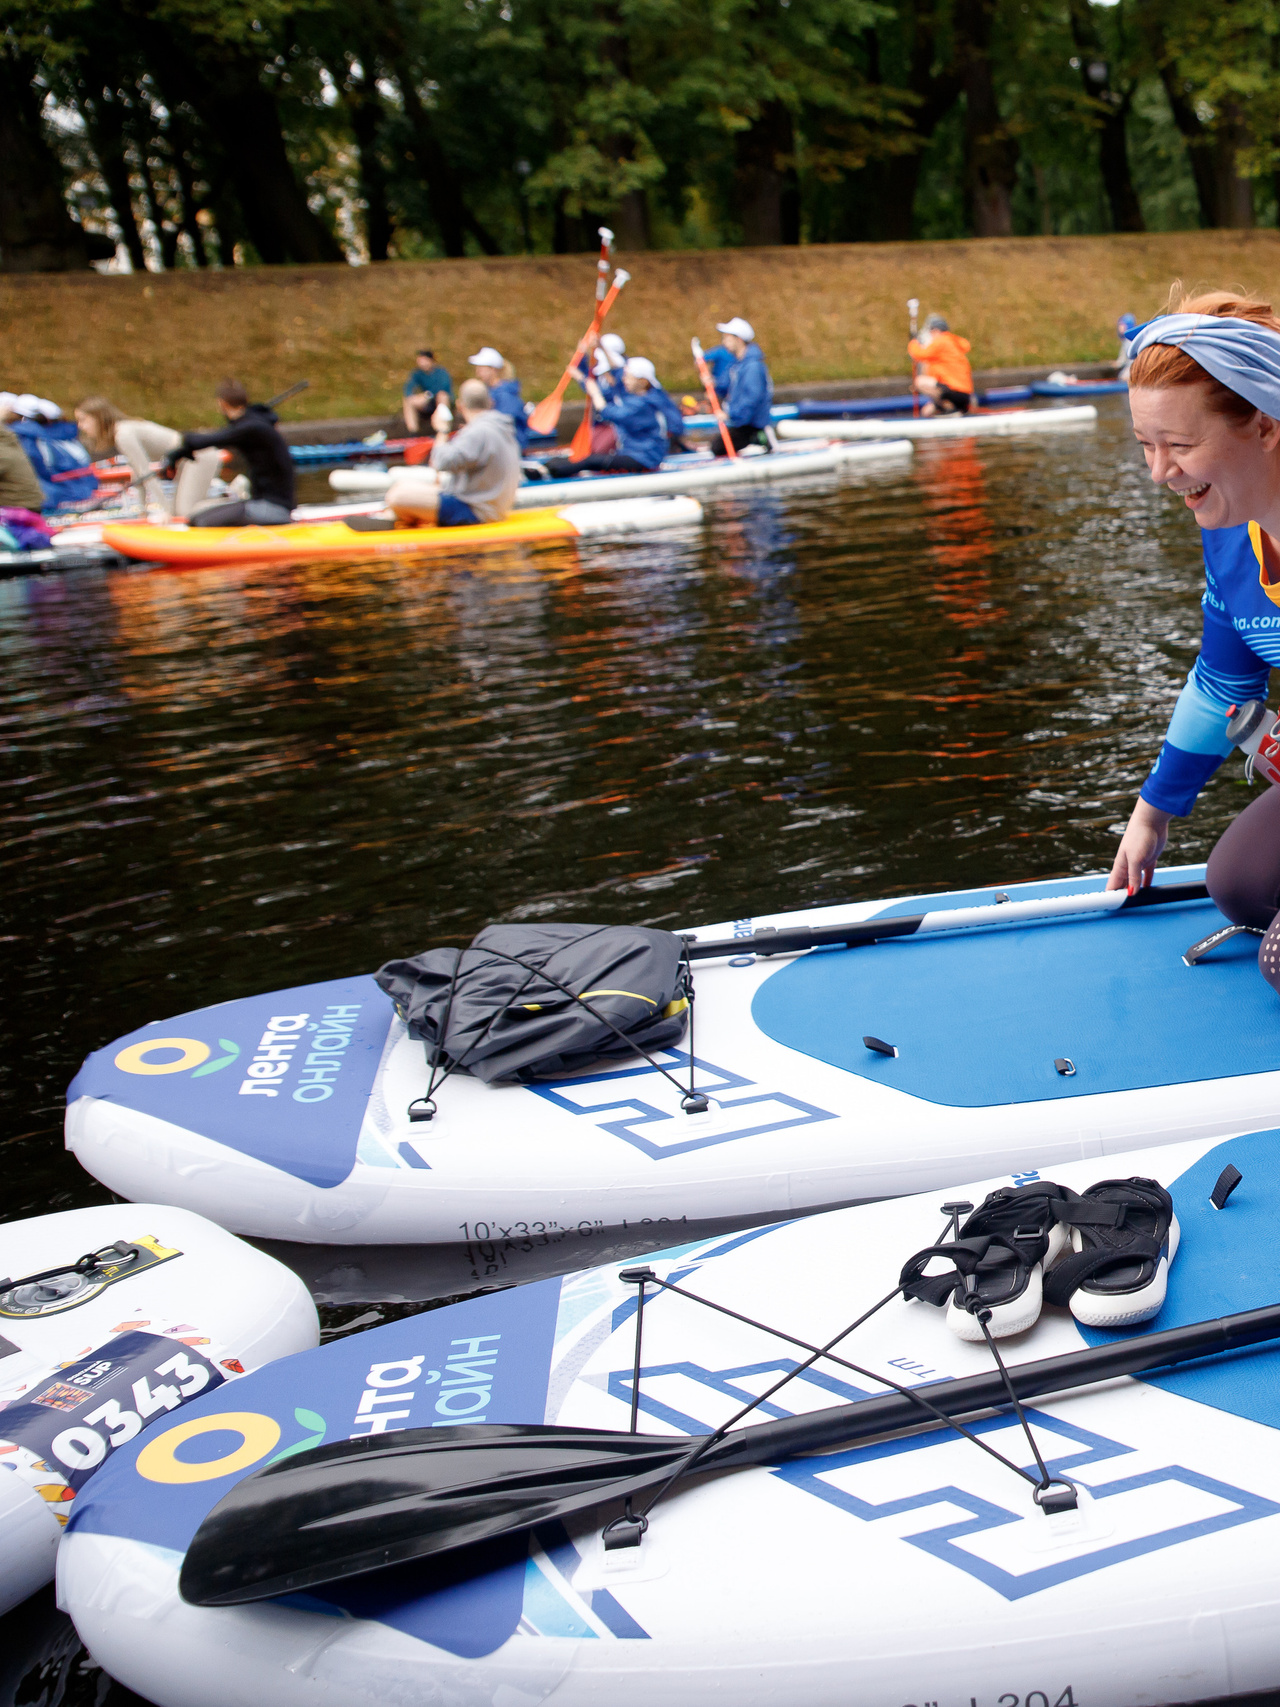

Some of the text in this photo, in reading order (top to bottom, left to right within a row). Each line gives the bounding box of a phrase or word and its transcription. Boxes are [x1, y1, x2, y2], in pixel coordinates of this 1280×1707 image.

[238, 1013, 311, 1098] лента
[291, 1004, 363, 1104] онлайн
[51, 1351, 210, 1471] 0343
[72, 1360, 113, 1386] SUP
[348, 1354, 426, 1440] нта
